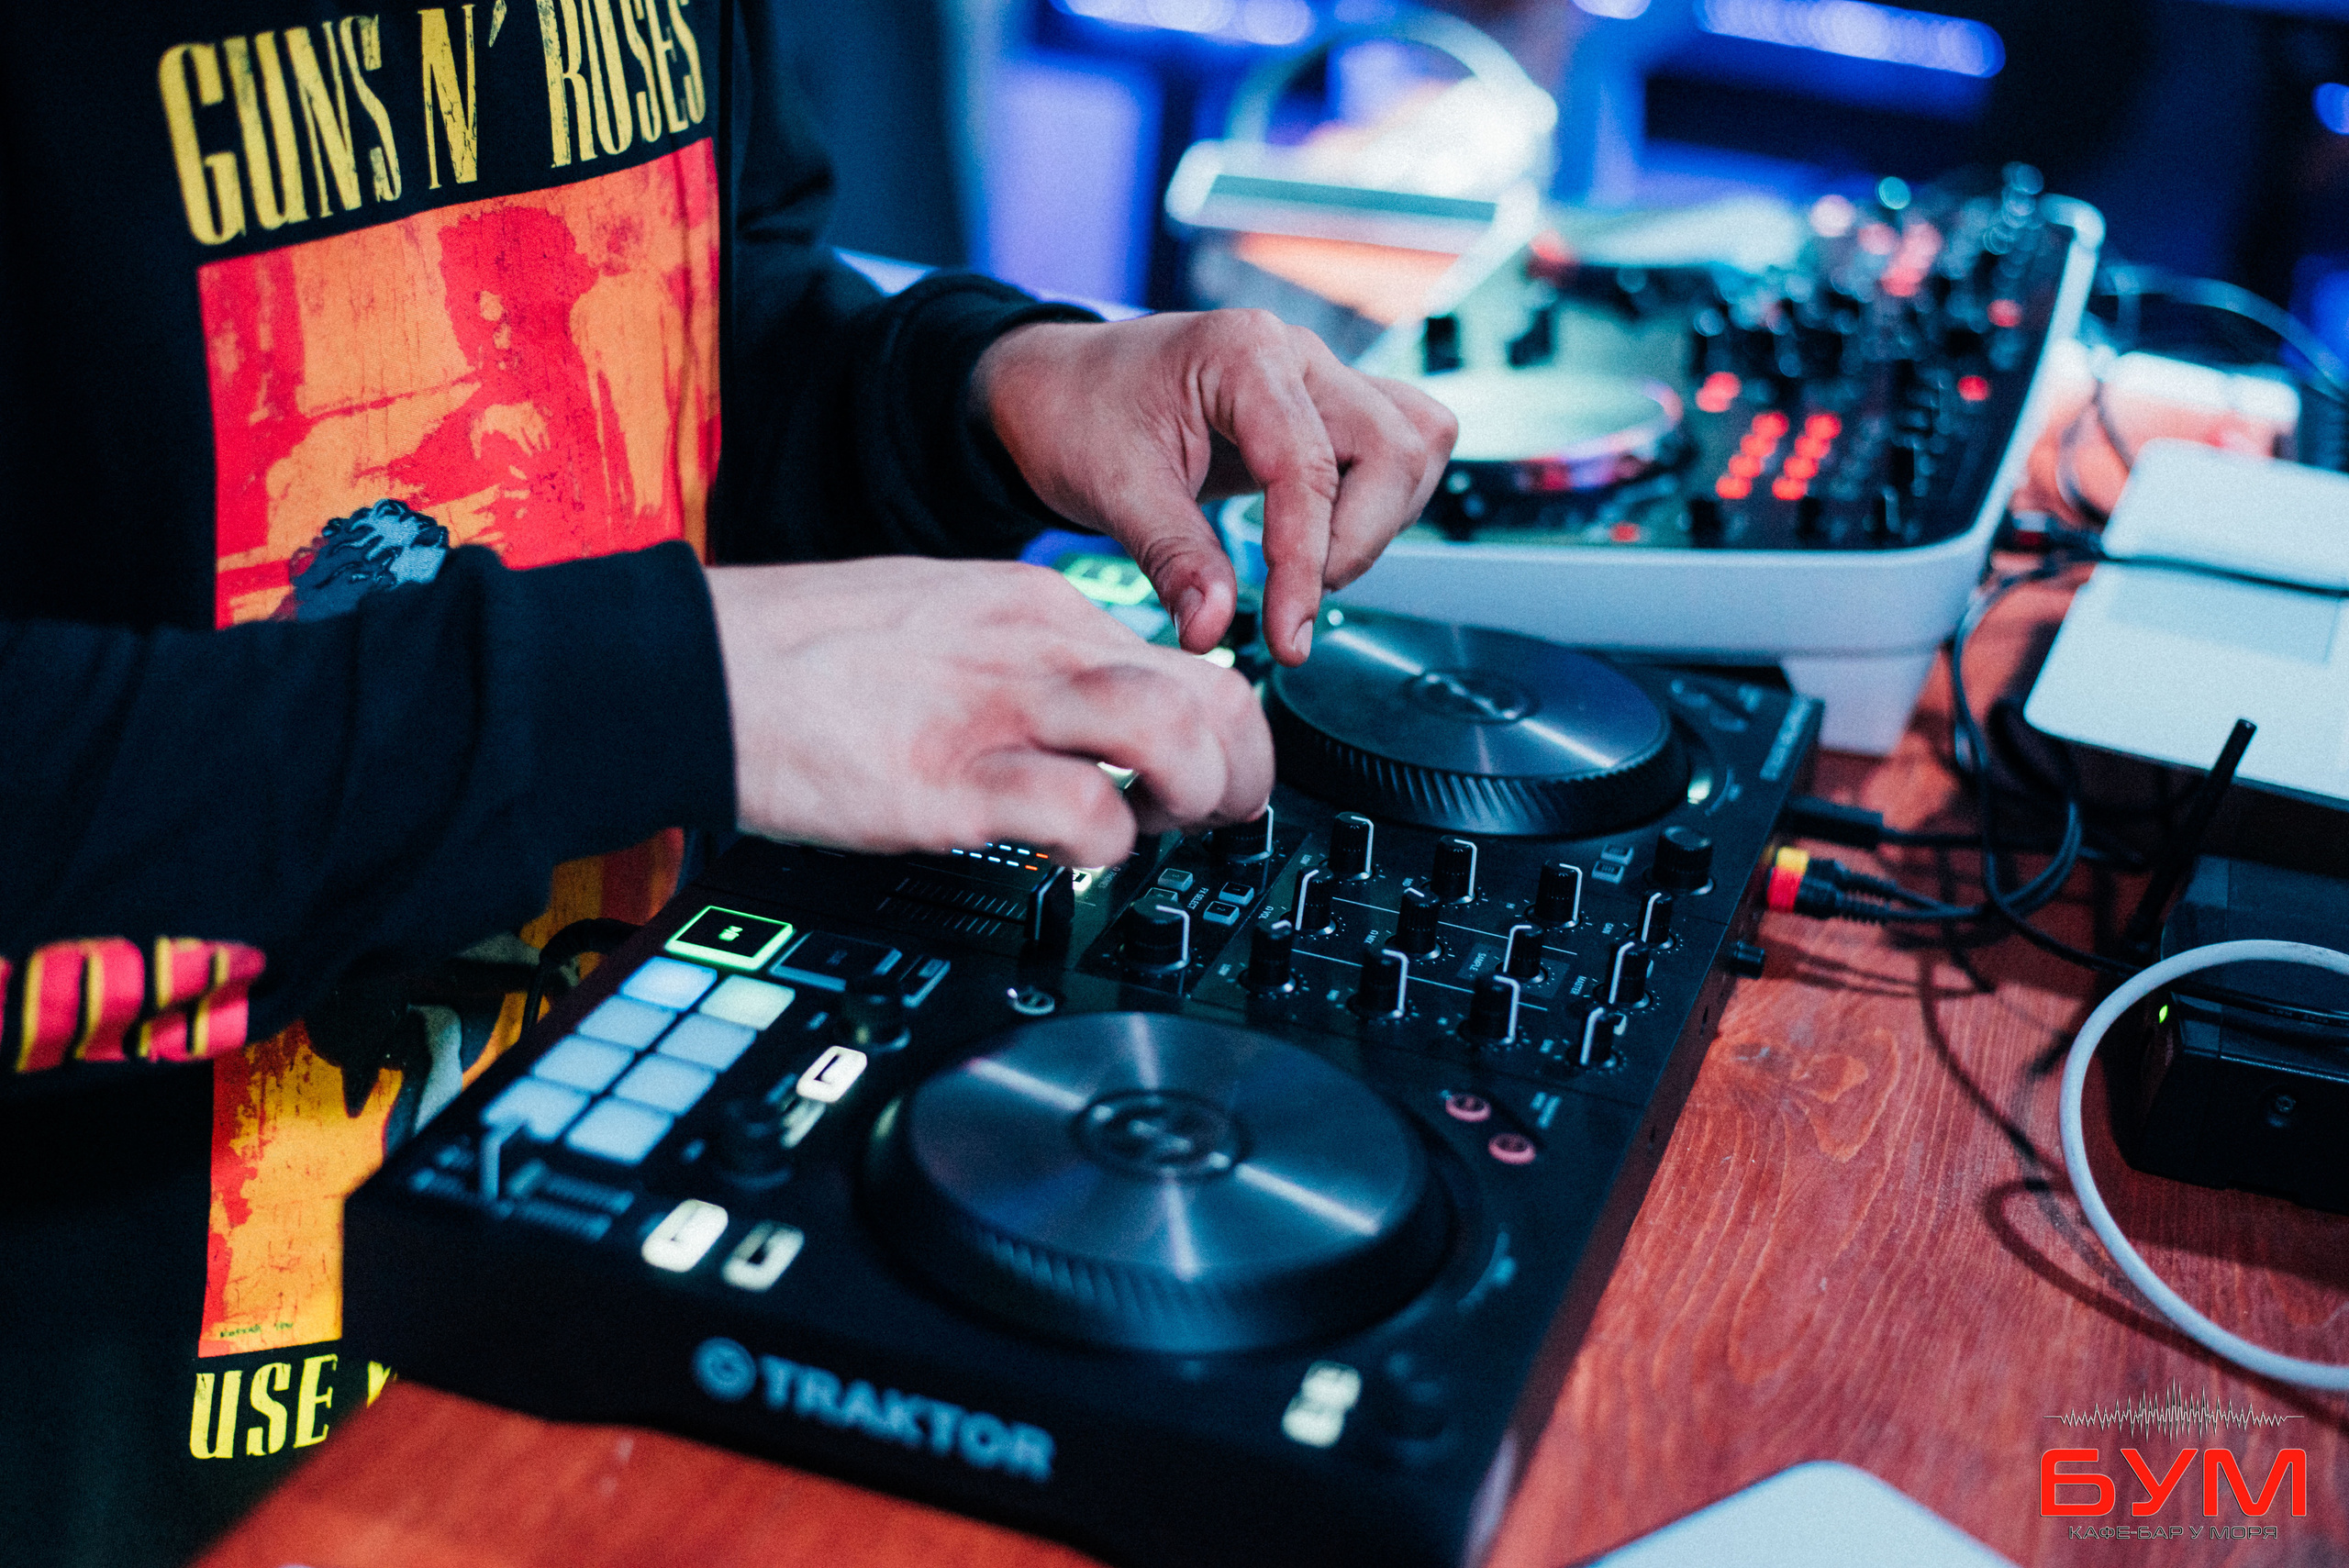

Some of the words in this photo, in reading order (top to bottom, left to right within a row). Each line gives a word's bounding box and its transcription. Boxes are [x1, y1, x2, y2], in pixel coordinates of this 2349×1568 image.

[159, 16, 402, 246] GUNS
[536, 0, 707, 169] ROSES
[1186, 893, 1207, 910] SELECT
[1258, 909, 1273, 920] VOL
[1469, 952, 1487, 972] SAMPLE
[1570, 974, 1588, 995] MASTER
[189, 1353, 339, 1460] USE
[759, 1353, 1055, 1480] TRAKTOR
